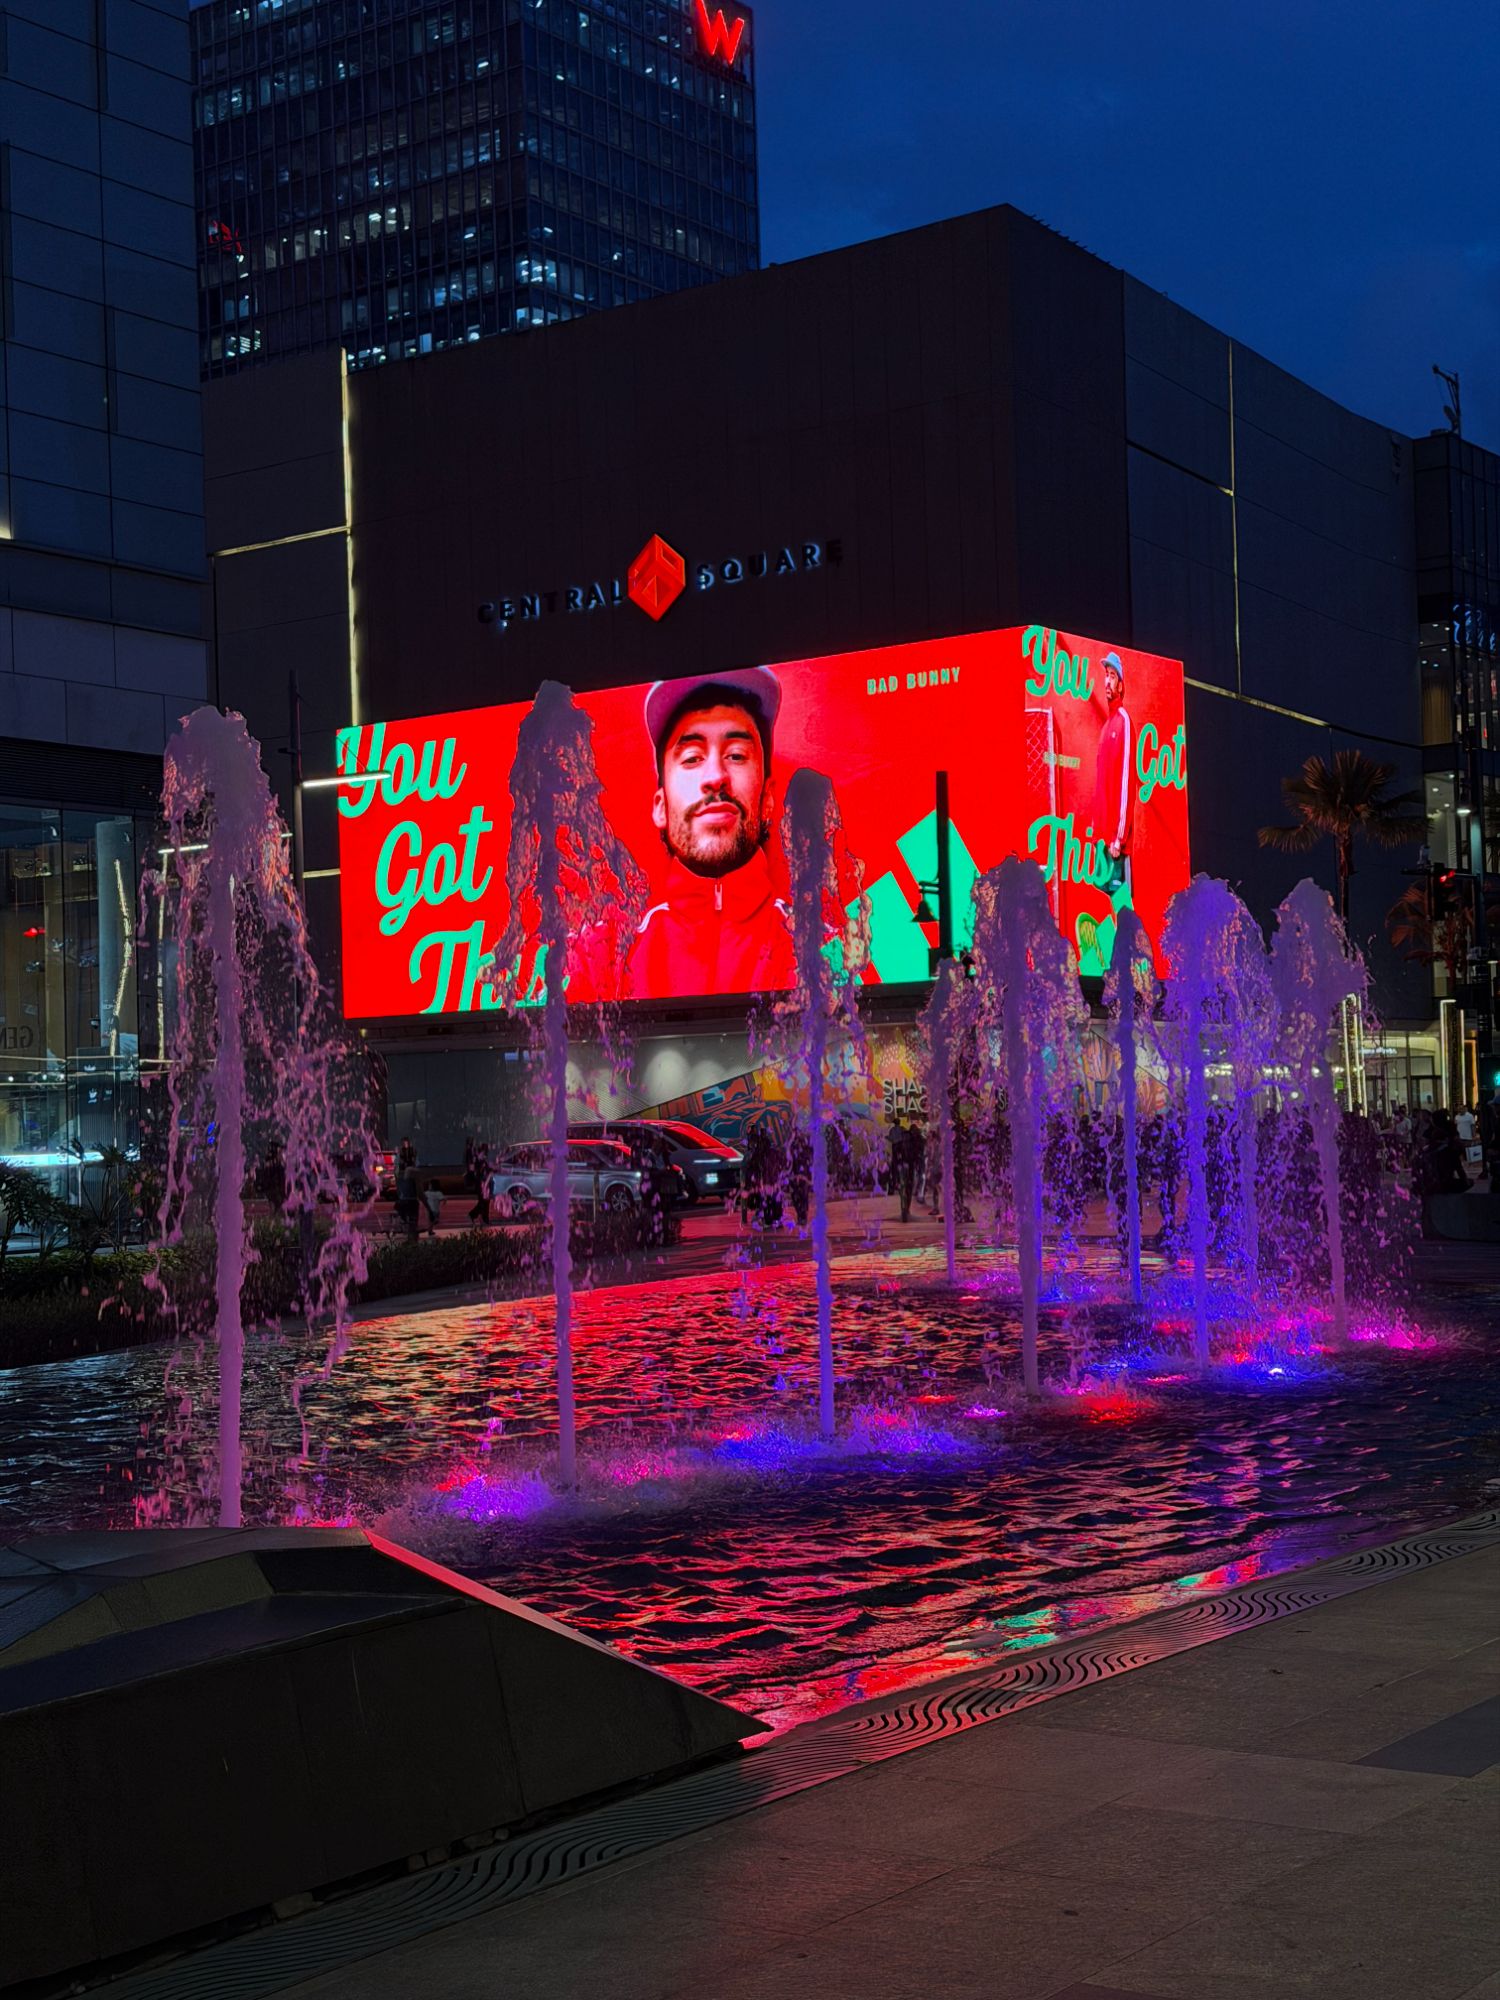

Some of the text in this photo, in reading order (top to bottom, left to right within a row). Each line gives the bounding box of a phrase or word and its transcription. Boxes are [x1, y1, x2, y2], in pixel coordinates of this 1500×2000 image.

[694, 0, 745, 64] W
[477, 539, 844, 624] CENTRAL SQUARE
[867, 666, 960, 695] BAD BUNNY
[1022, 625, 1094, 701] You
[337, 722, 468, 818] You
[1136, 723, 1187, 803] Got
[375, 806, 493, 936] Got
[1027, 813, 1116, 886] This
